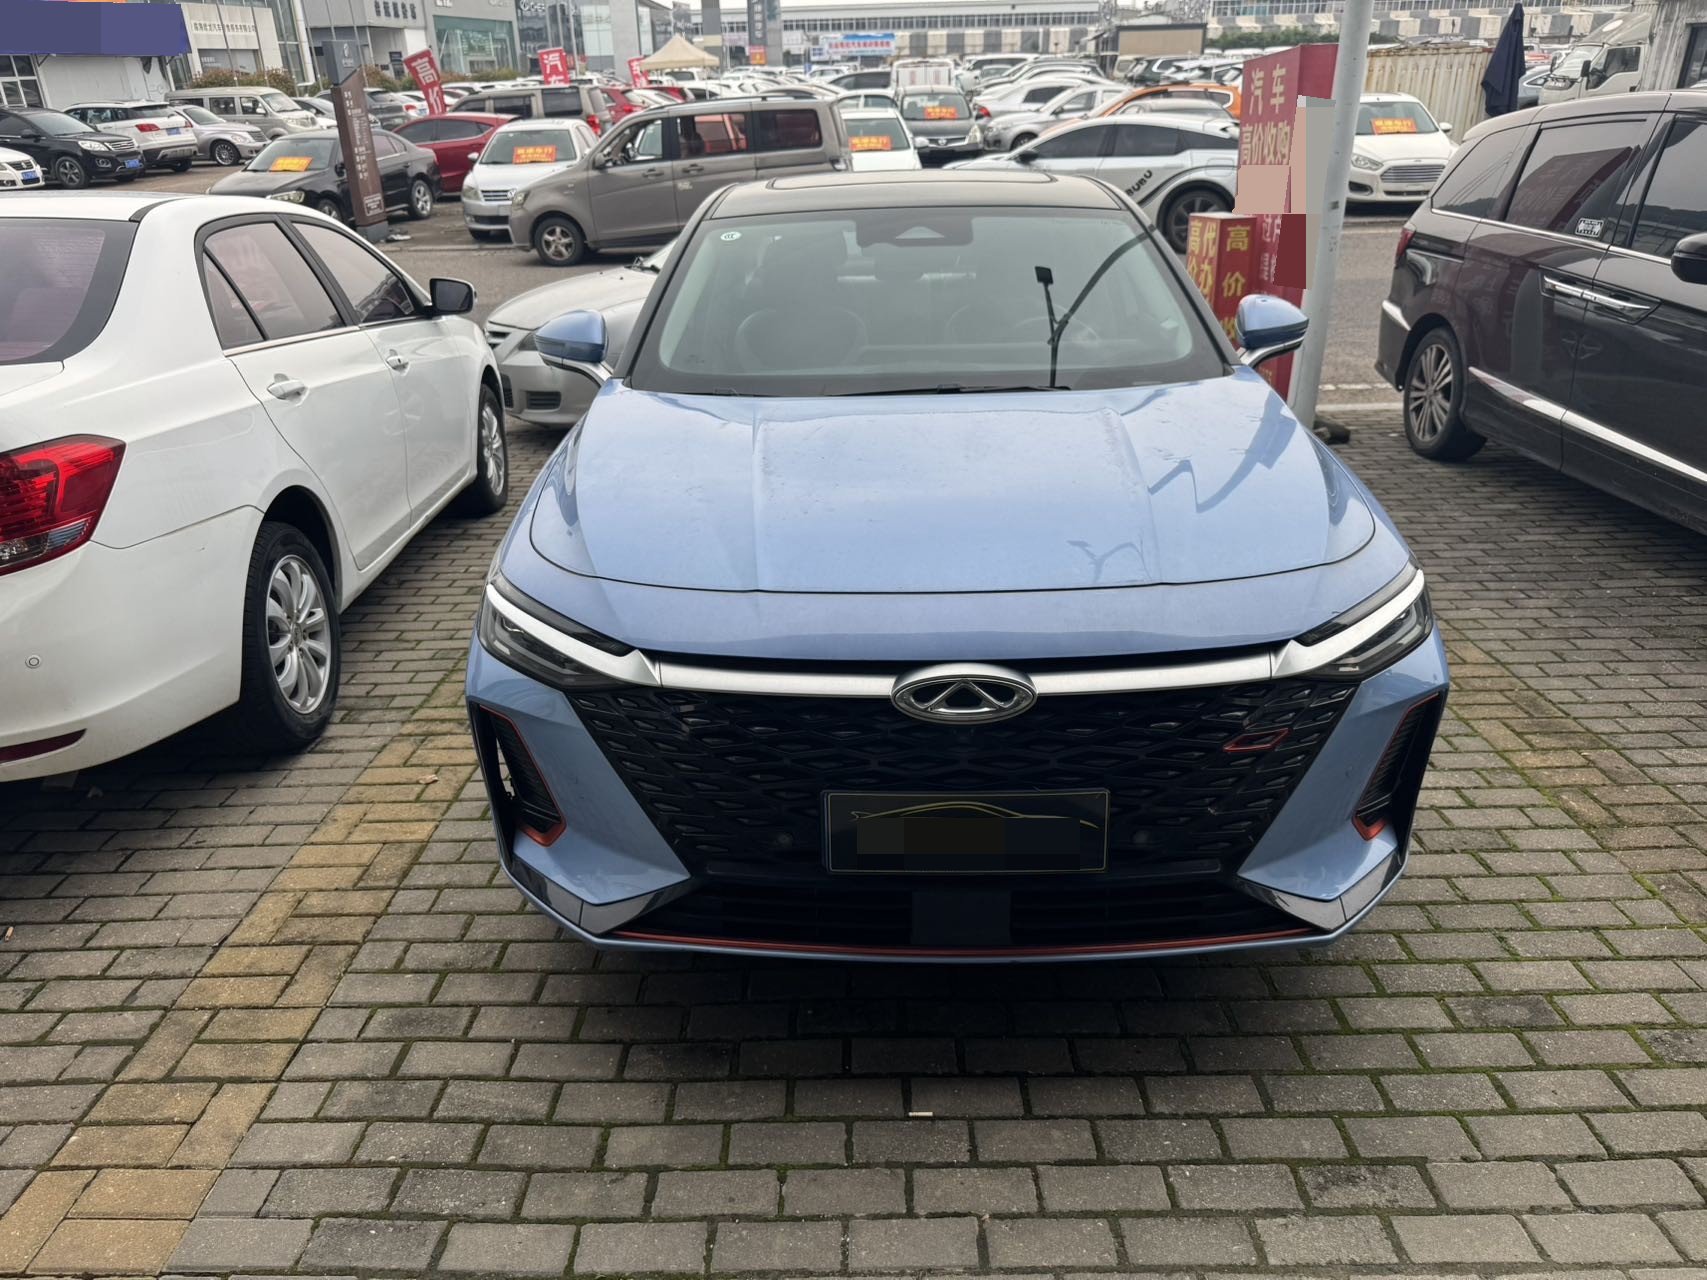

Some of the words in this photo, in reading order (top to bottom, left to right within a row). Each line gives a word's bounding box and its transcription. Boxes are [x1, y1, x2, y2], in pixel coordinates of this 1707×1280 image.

[411, 56, 442, 115] 高价
[1249, 64, 1286, 115] 汽车
[1241, 120, 1291, 165] 高价收购
